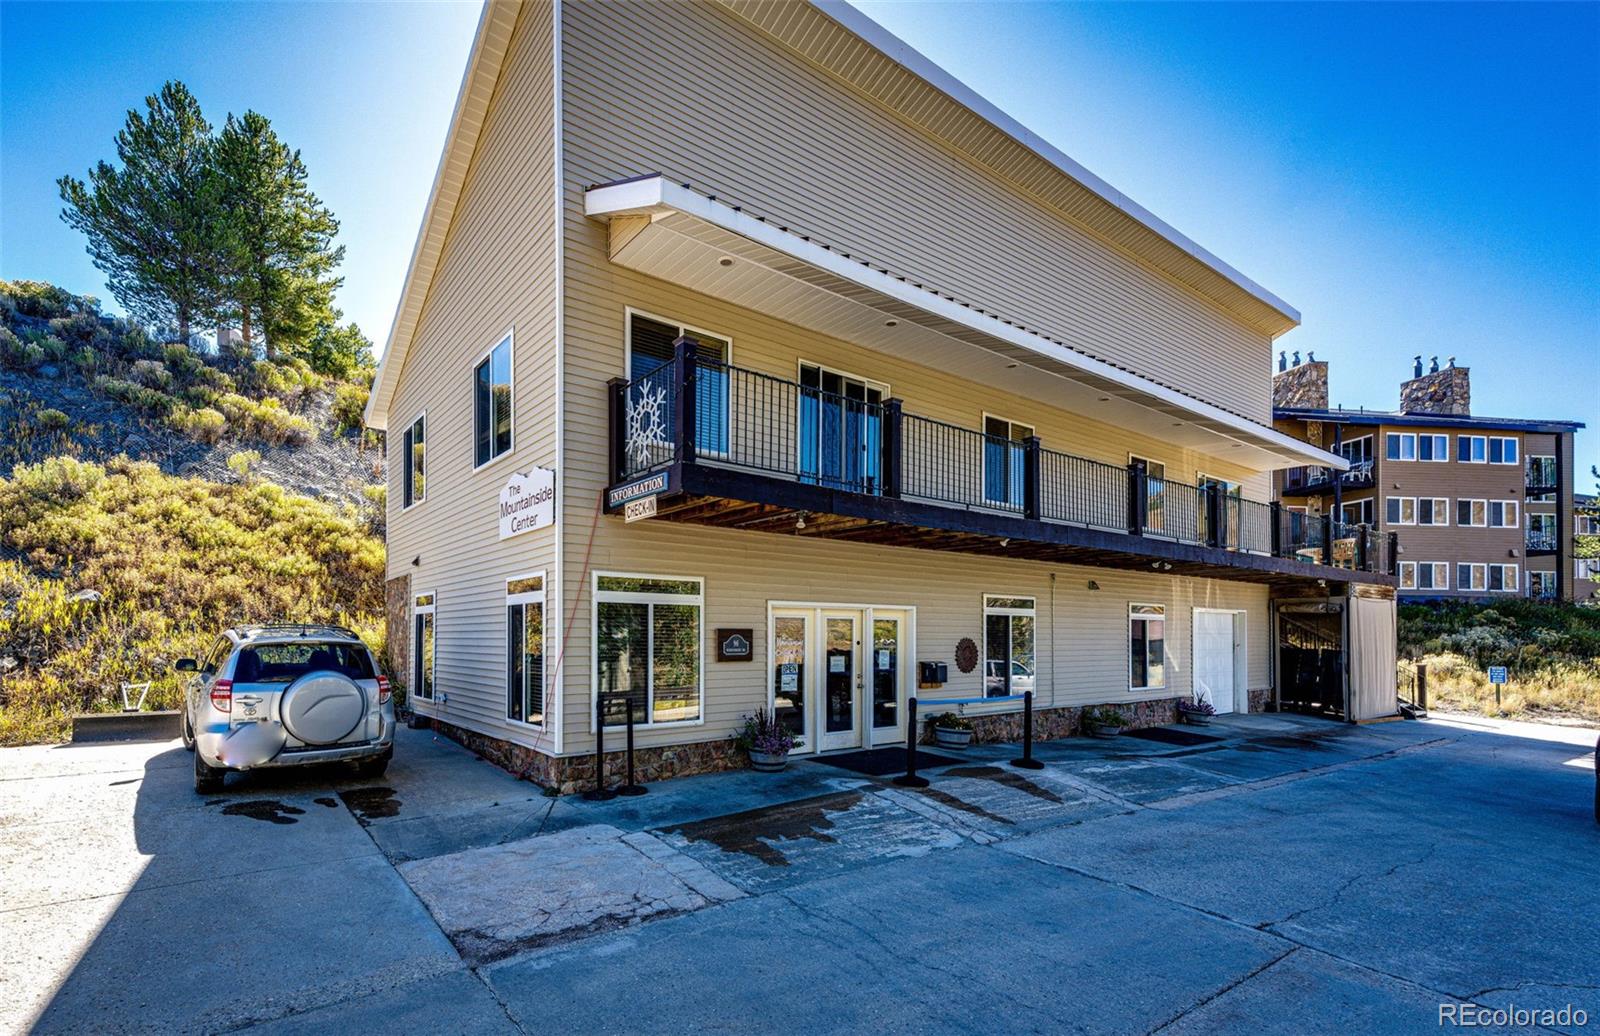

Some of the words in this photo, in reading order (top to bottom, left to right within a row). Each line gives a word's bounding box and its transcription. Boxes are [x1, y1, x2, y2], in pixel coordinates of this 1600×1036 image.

[508, 485, 521, 498] The
[611, 476, 663, 503] INFORMATION
[500, 486, 553, 518] Mountainside
[626, 501, 656, 520] CHECK-IN
[510, 513, 539, 533] Center
